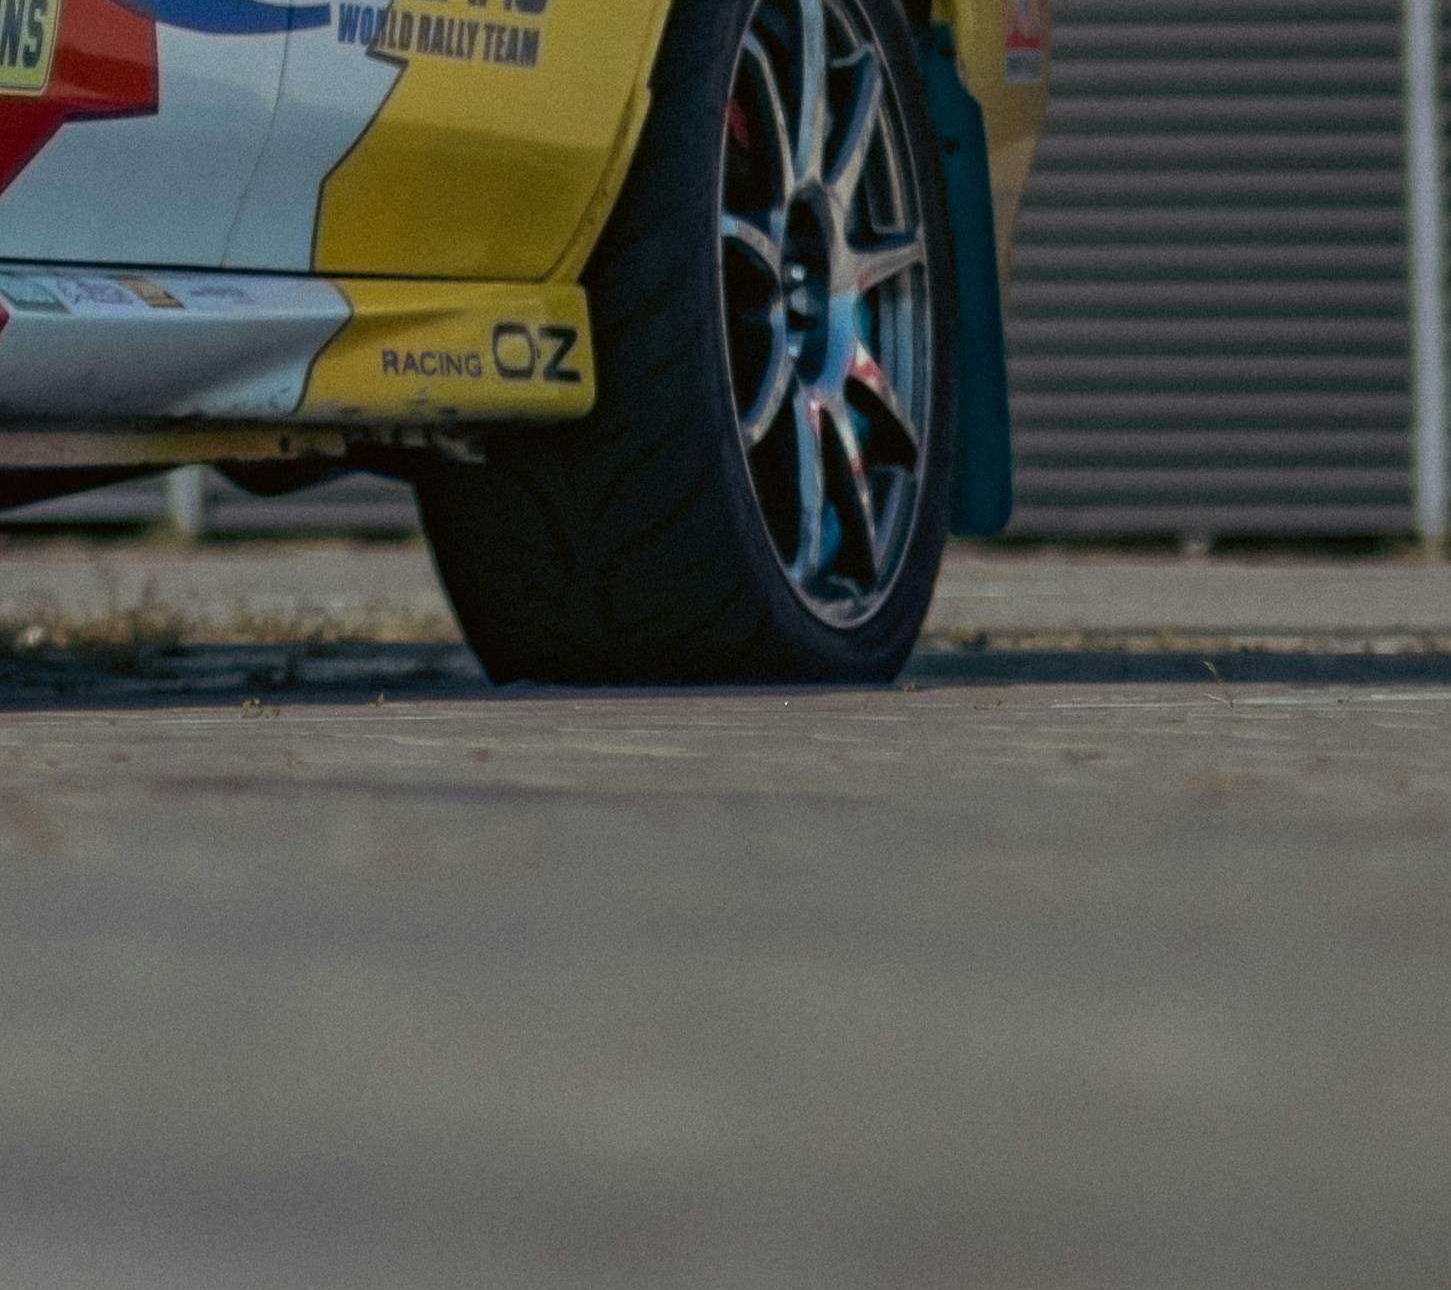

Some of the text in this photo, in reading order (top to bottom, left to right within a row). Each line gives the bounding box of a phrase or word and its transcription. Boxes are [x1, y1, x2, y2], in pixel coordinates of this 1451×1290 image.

[338, 2, 540, 68] WORLD RALLY TEAM
[381, 348, 483, 379] RACING
